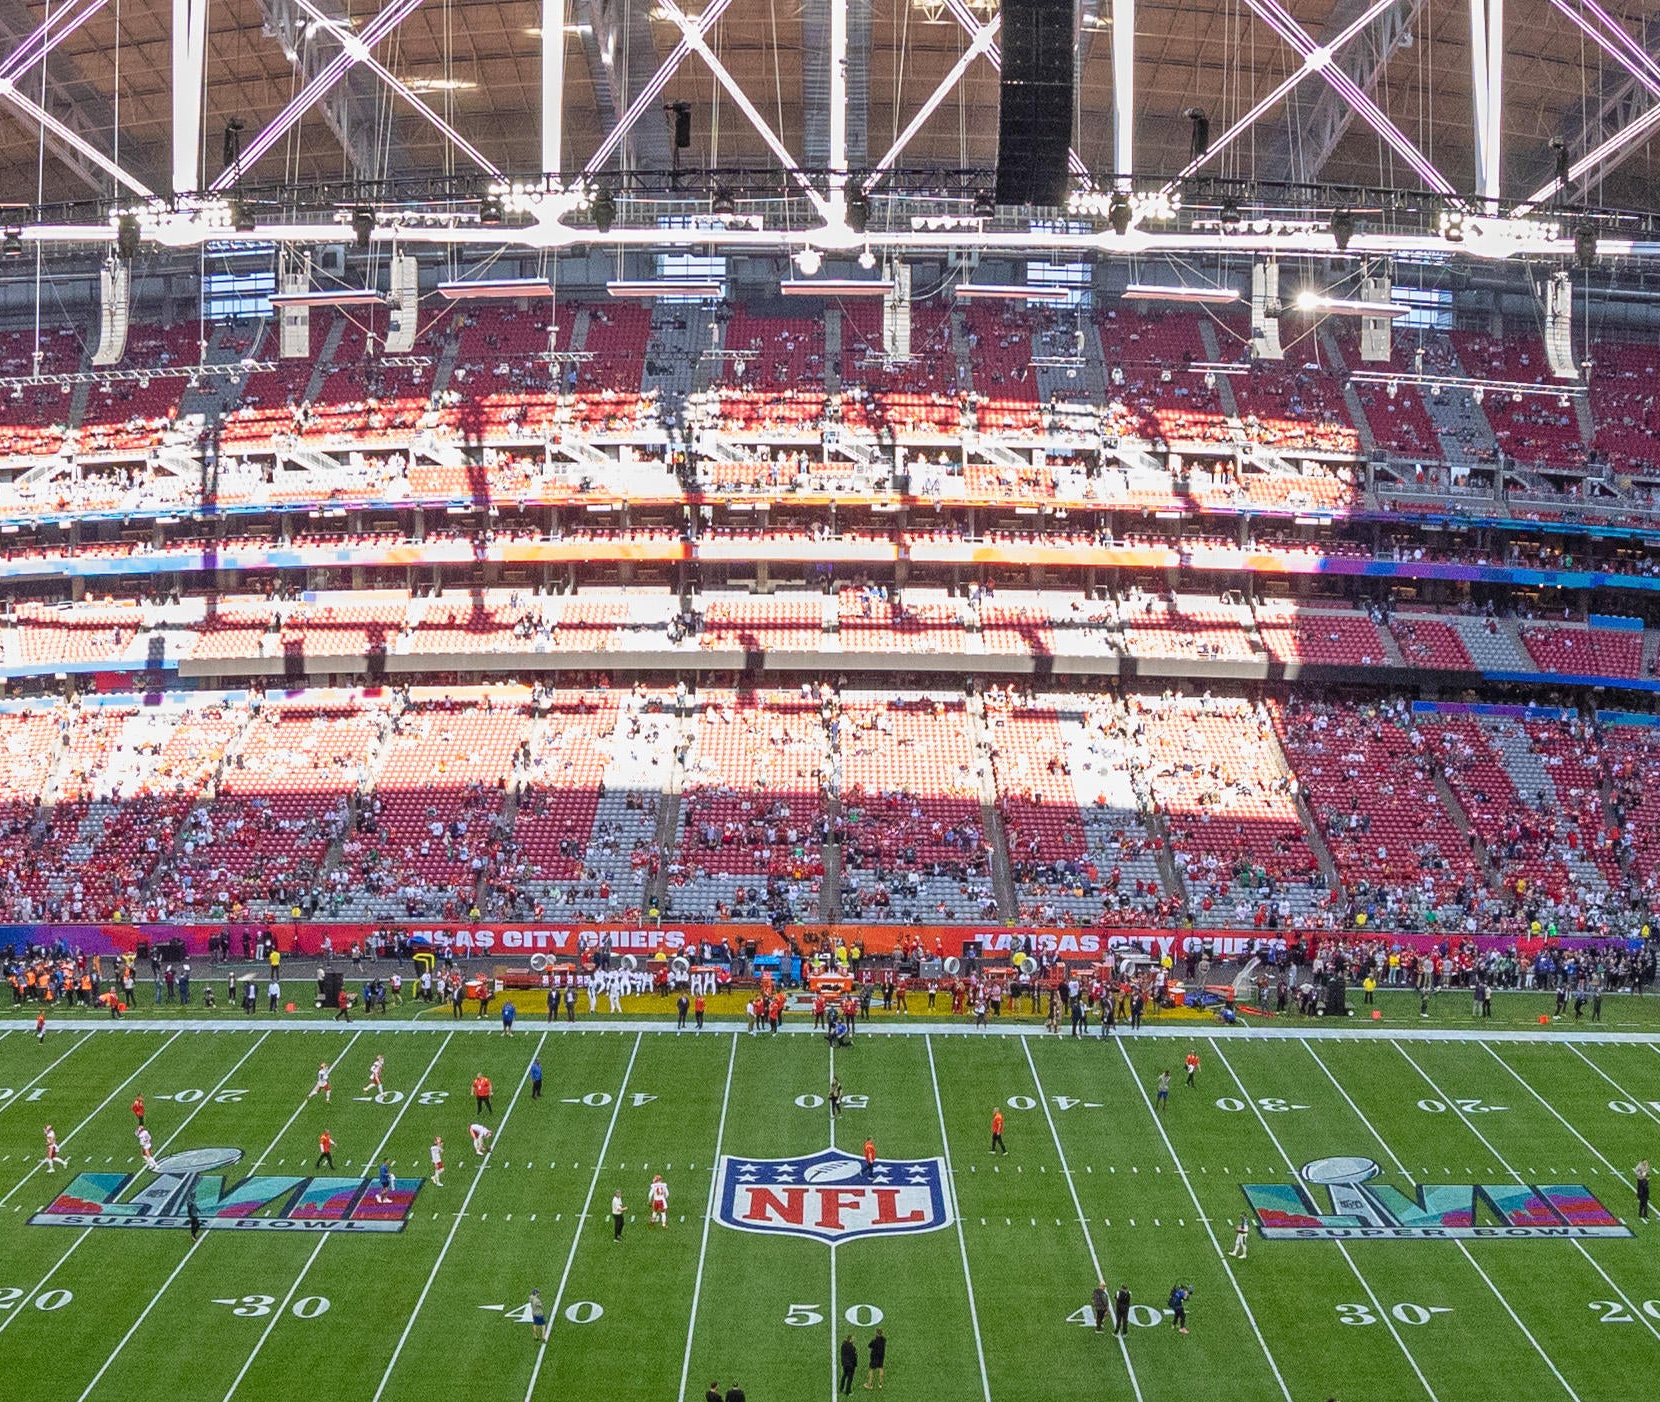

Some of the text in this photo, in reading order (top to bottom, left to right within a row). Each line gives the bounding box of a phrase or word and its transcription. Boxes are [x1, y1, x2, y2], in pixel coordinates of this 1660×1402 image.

[503, 930, 570, 948] CITY
[742, 1188, 925, 1230] NFL
[238, 1219, 367, 1231] BOWL
[1297, 1227, 1601, 1238] SUPER BOWL
[232, 1295, 331, 1319] 30
[784, 1304, 883, 1328] 50
[1335, 1303, 1430, 1326] 30
